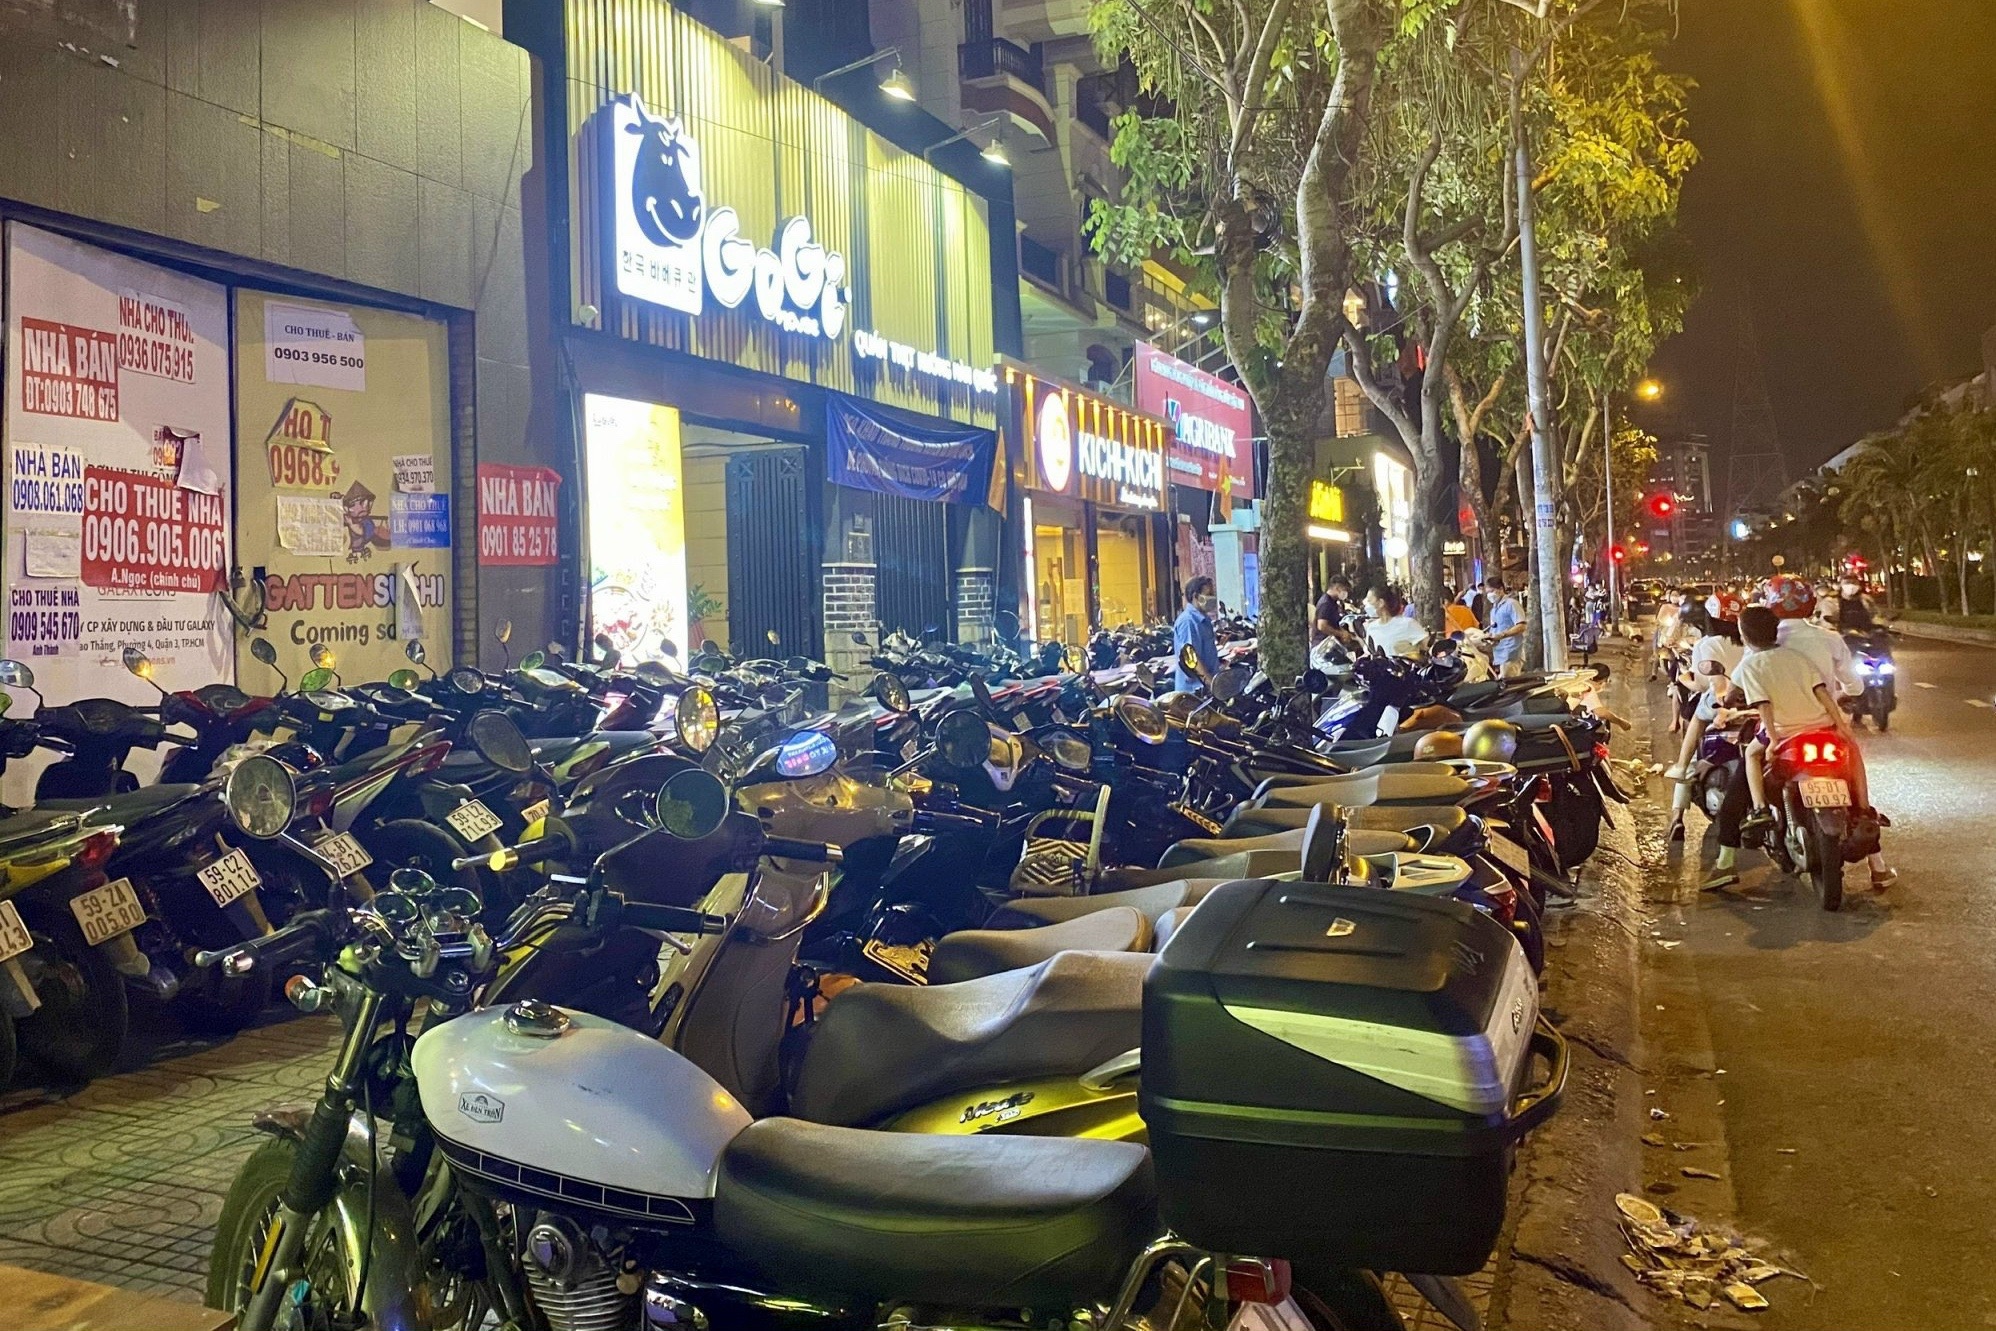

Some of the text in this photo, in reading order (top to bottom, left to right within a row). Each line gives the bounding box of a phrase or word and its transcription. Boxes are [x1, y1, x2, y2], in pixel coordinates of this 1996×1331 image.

[119, 292, 142, 330] NHÀ
[145, 303, 165, 336] CHO
[284, 325, 303, 335] CHO
[305, 328, 330, 339] THUÊ
[337, 331, 355, 342] BÁN
[24, 325, 115, 384] NHÀ BÁN
[120, 333, 193, 381] 0936 075 915
[274, 347, 364, 369] 0903 956 500
[76, 383, 95, 418] 748
[98, 387, 116, 420] 675
[15, 444, 81, 479] NHÀ BÁN
[406, 458, 418, 467] CHO
[1079, 430, 1162, 492] KICHI-KICHI
[13, 479, 83, 513] 0908.061.068
[85, 477, 128, 514] CHO
[481, 470, 556, 517] NHÀ BÁN
[85, 514, 222, 571] 0906.905.006
[481, 525, 508, 557] 0901
[512, 525, 526, 557] 85
[529, 525, 542, 557] 25
[544, 526, 557, 557] 78
[11, 586, 80, 607] CHO THUÊ NHÀ
[111, 568, 201, 591] A.Ngọc (chính chủ)
[11, 611, 80, 641] 0909 545 670
[86, 621, 99, 632] CP
[101, 617, 118, 632] XÂY
[119, 620, 145, 635] DỰNG
[147, 620, 154, 632] &
[187, 620, 215, 631] GALAXY
[290, 619, 369, 646] Coming
[461, 814, 498, 840] 714.93
[204, 855, 243, 885] 59-C2
[213, 869, 258, 904] 801.14
[85, 903, 140, 940] 005.80
